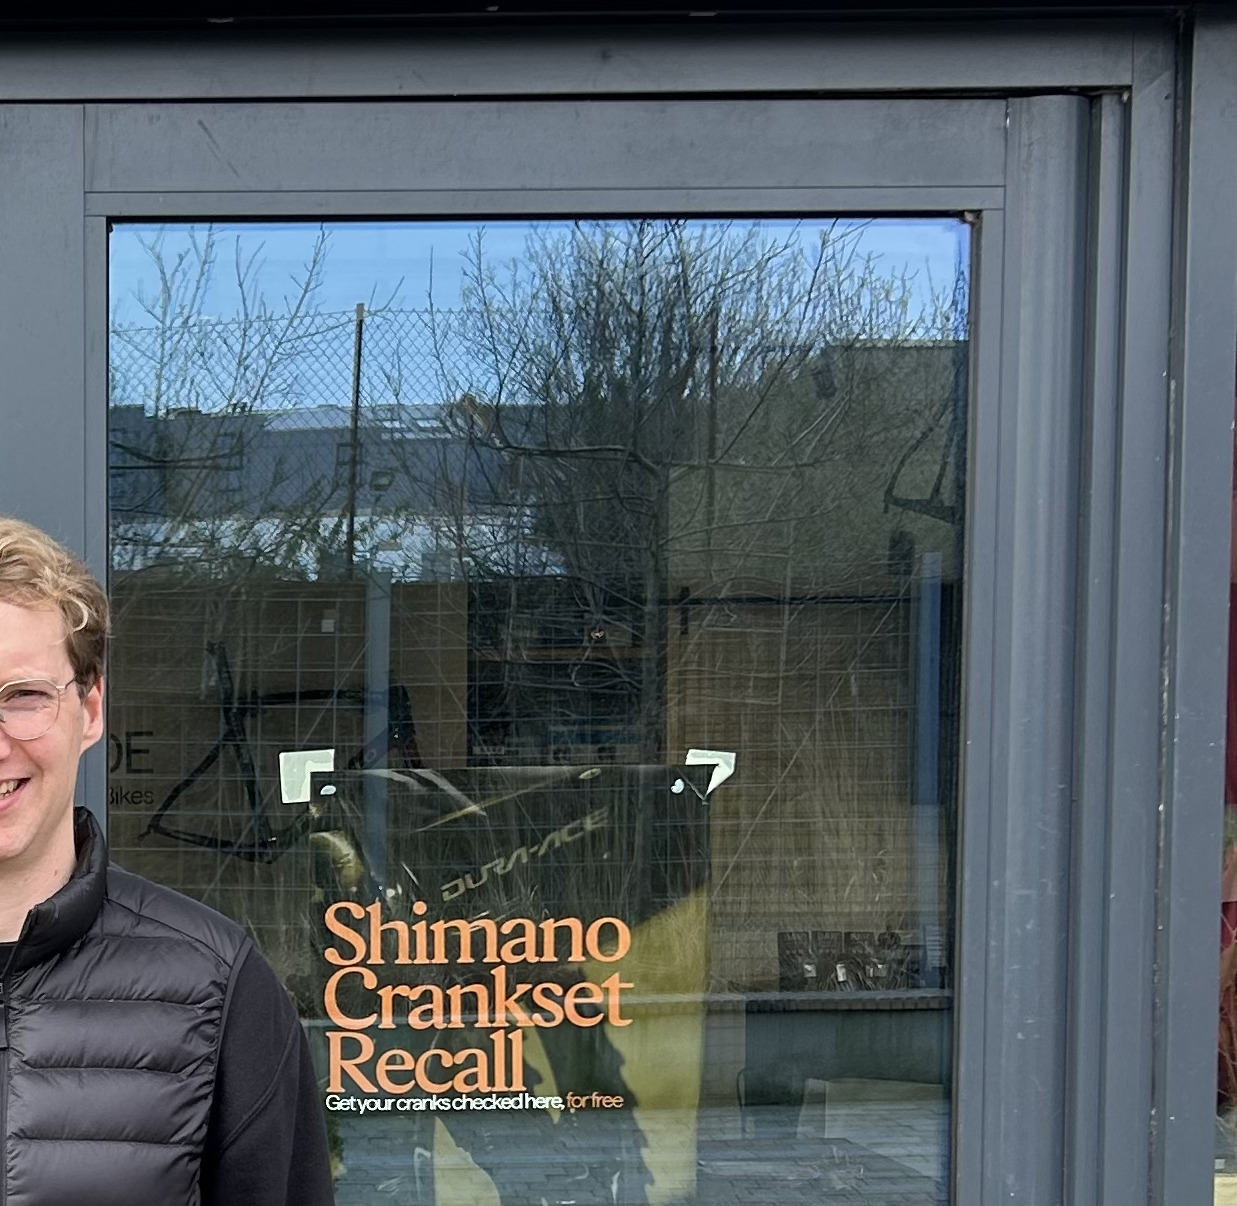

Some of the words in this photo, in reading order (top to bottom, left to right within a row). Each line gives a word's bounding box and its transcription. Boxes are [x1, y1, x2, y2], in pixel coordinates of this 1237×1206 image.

[440, 807, 608, 901] DURA-ACE
[324, 901, 631, 965] Shimano
[324, 965, 634, 1029] Crankset
[325, 1029, 526, 1093] Recall
[325, 1094, 357, 1111] Get
[356, 1098, 396, 1114] your
[396, 1094, 451, 1111] cranks
[451, 1093, 524, 1110] checked
[524, 1093, 565, 1110] here,
[566, 1092, 590, 1108] for
[590, 1092, 624, 1108] free
